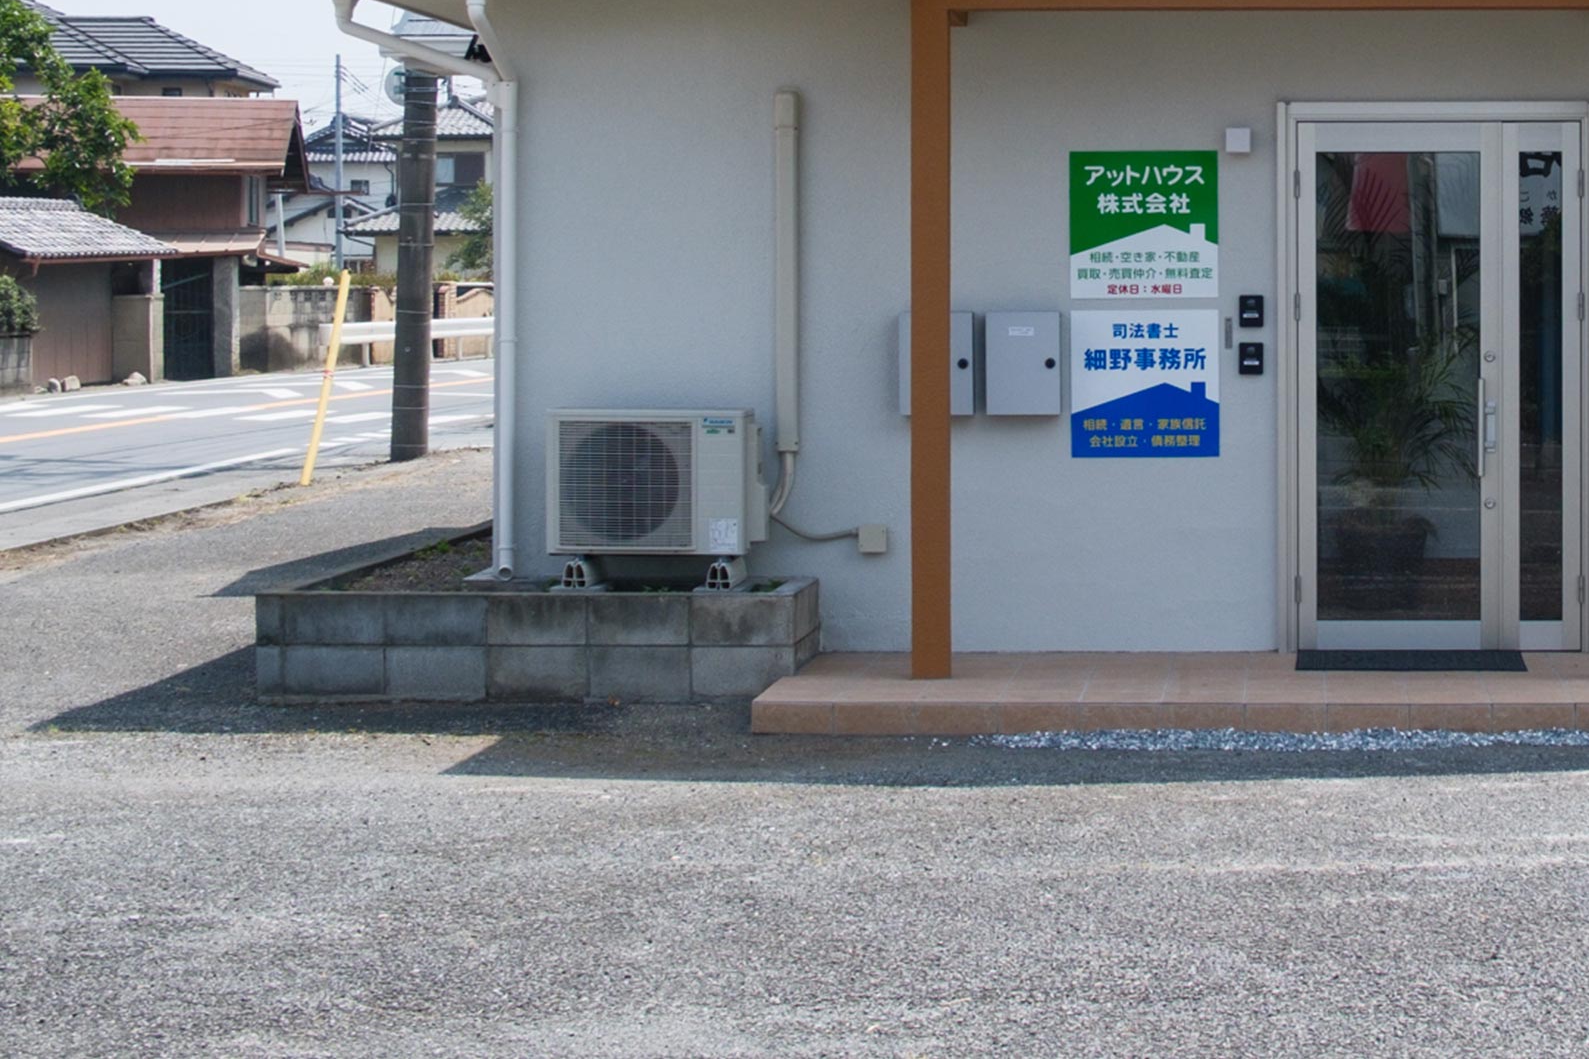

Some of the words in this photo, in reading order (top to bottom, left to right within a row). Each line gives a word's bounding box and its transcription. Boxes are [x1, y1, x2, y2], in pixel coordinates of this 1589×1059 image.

[1083, 164, 1205, 187] アットハウス
[1096, 192, 1191, 215] 株式会社
[1112, 323, 1180, 339] 司法書士
[1083, 347, 1207, 371] 細野事務所
